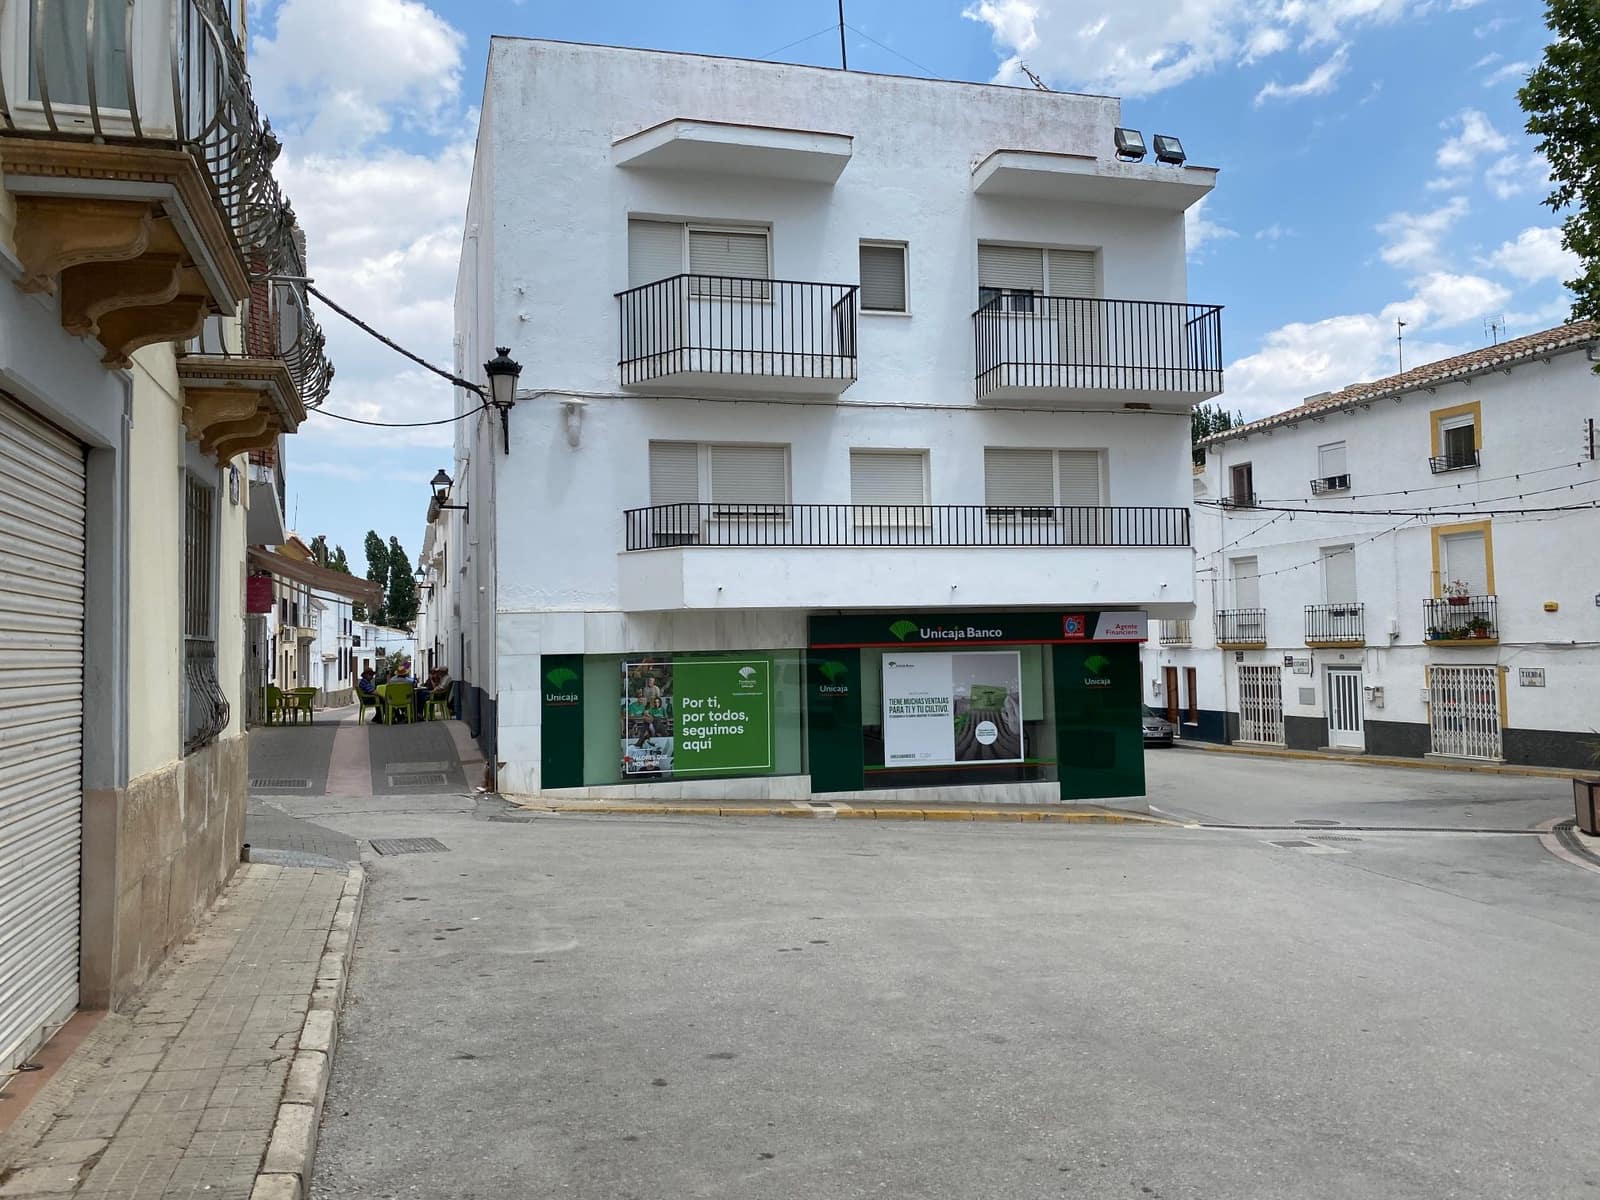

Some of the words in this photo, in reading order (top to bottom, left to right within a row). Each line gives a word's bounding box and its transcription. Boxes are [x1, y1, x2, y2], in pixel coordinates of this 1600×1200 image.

[1115, 623, 1137, 631] Agente
[920, 626, 965, 640] Unicaja
[967, 627, 1002, 638] Banco
[1084, 677, 1110, 687] Unicaja
[819, 684, 848, 693] Unicaja
[546, 692, 578, 702] Unicaja
[924, 696, 949, 704] VENTAJAS
[682, 697, 704, 709] Por
[707, 696, 720, 709] ti,
[889, 705, 904, 714] PARA
[917, 704, 924, 713] TU
[682, 713, 705, 726] por
[709, 709, 749, 722] todos,
[682, 723, 744, 739] seguimos
